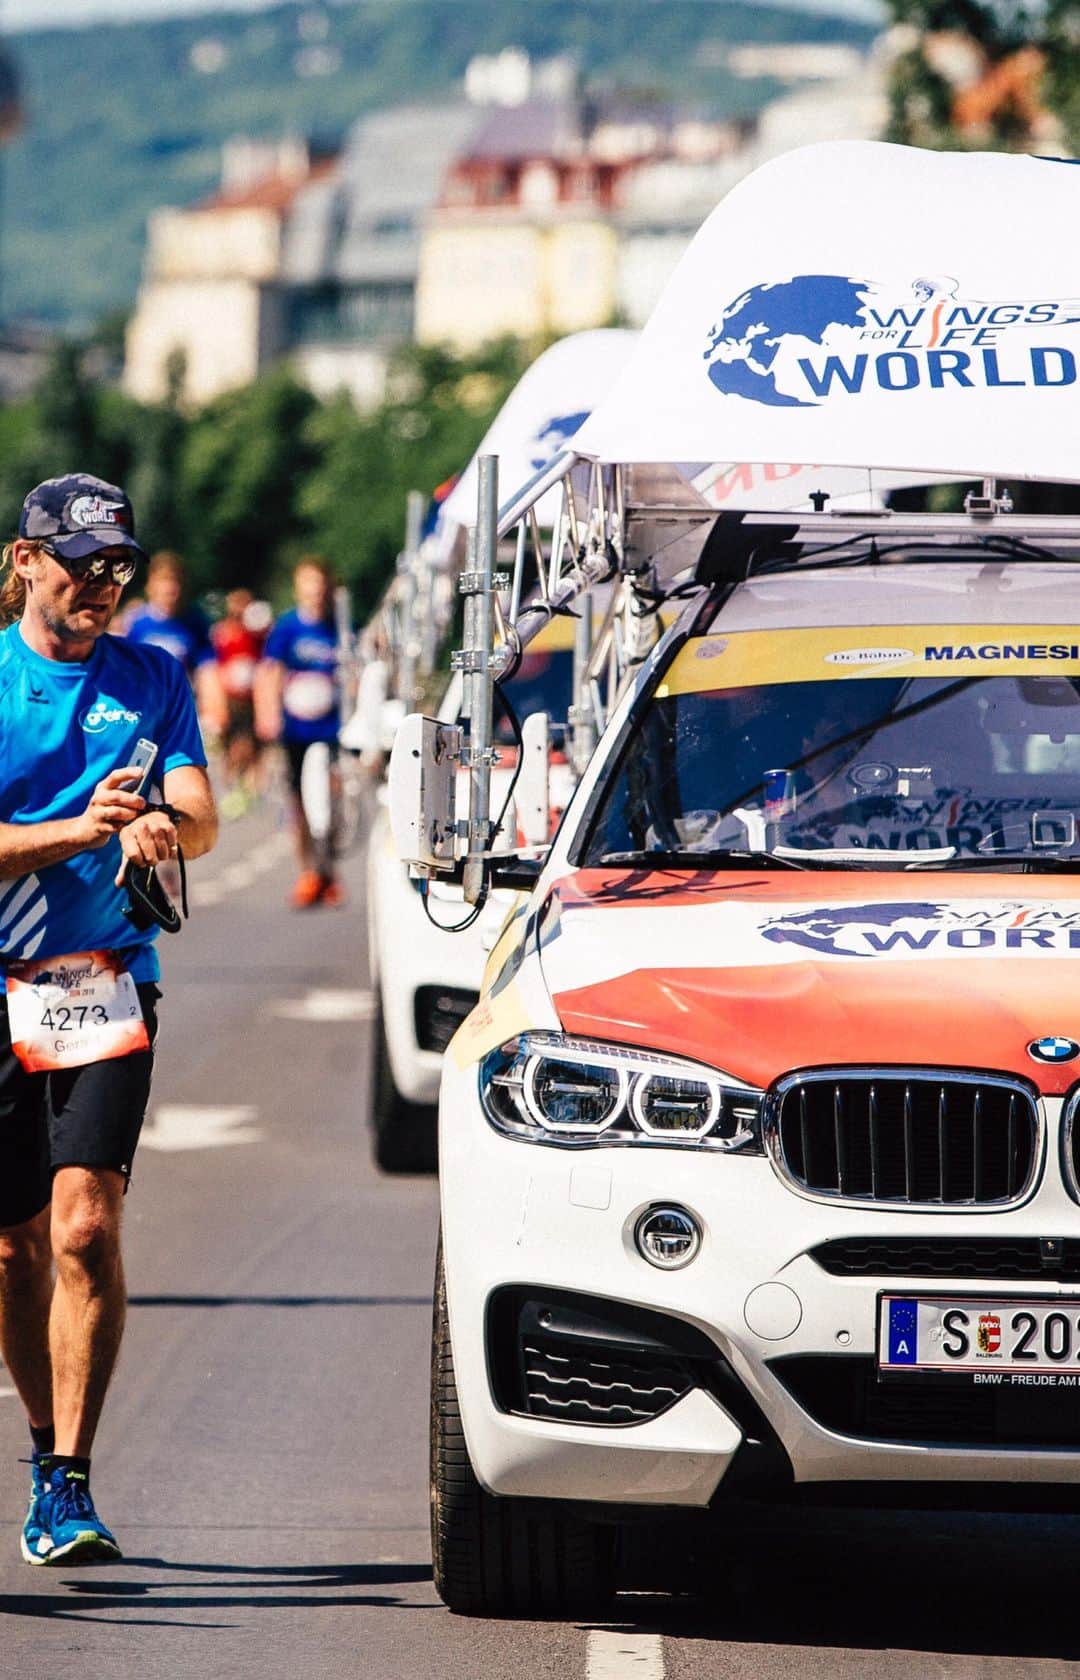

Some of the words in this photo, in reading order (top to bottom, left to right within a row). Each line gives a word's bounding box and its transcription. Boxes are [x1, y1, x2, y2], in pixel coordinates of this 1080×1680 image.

[869, 300, 1060, 328] WINGS
[859, 330, 898, 341] FOR
[896, 326, 1006, 349] LIFE
[797, 346, 1078, 397] WORLD
[81, 511, 116, 523] WORLD
[924, 644, 1080, 661] MAGNESI
[40, 1004, 109, 1031] 4273
[129, 1006, 137, 1016] 2
[942, 1309, 970, 1357] S
[1011, 1311, 1080, 1361] 20
[896, 1340, 909, 1354] A
[973, 1373, 1003, 1385] BMW
[1011, 1374, 1057, 1386] FREUDE
[1057, 1375, 1077, 1387] AM
